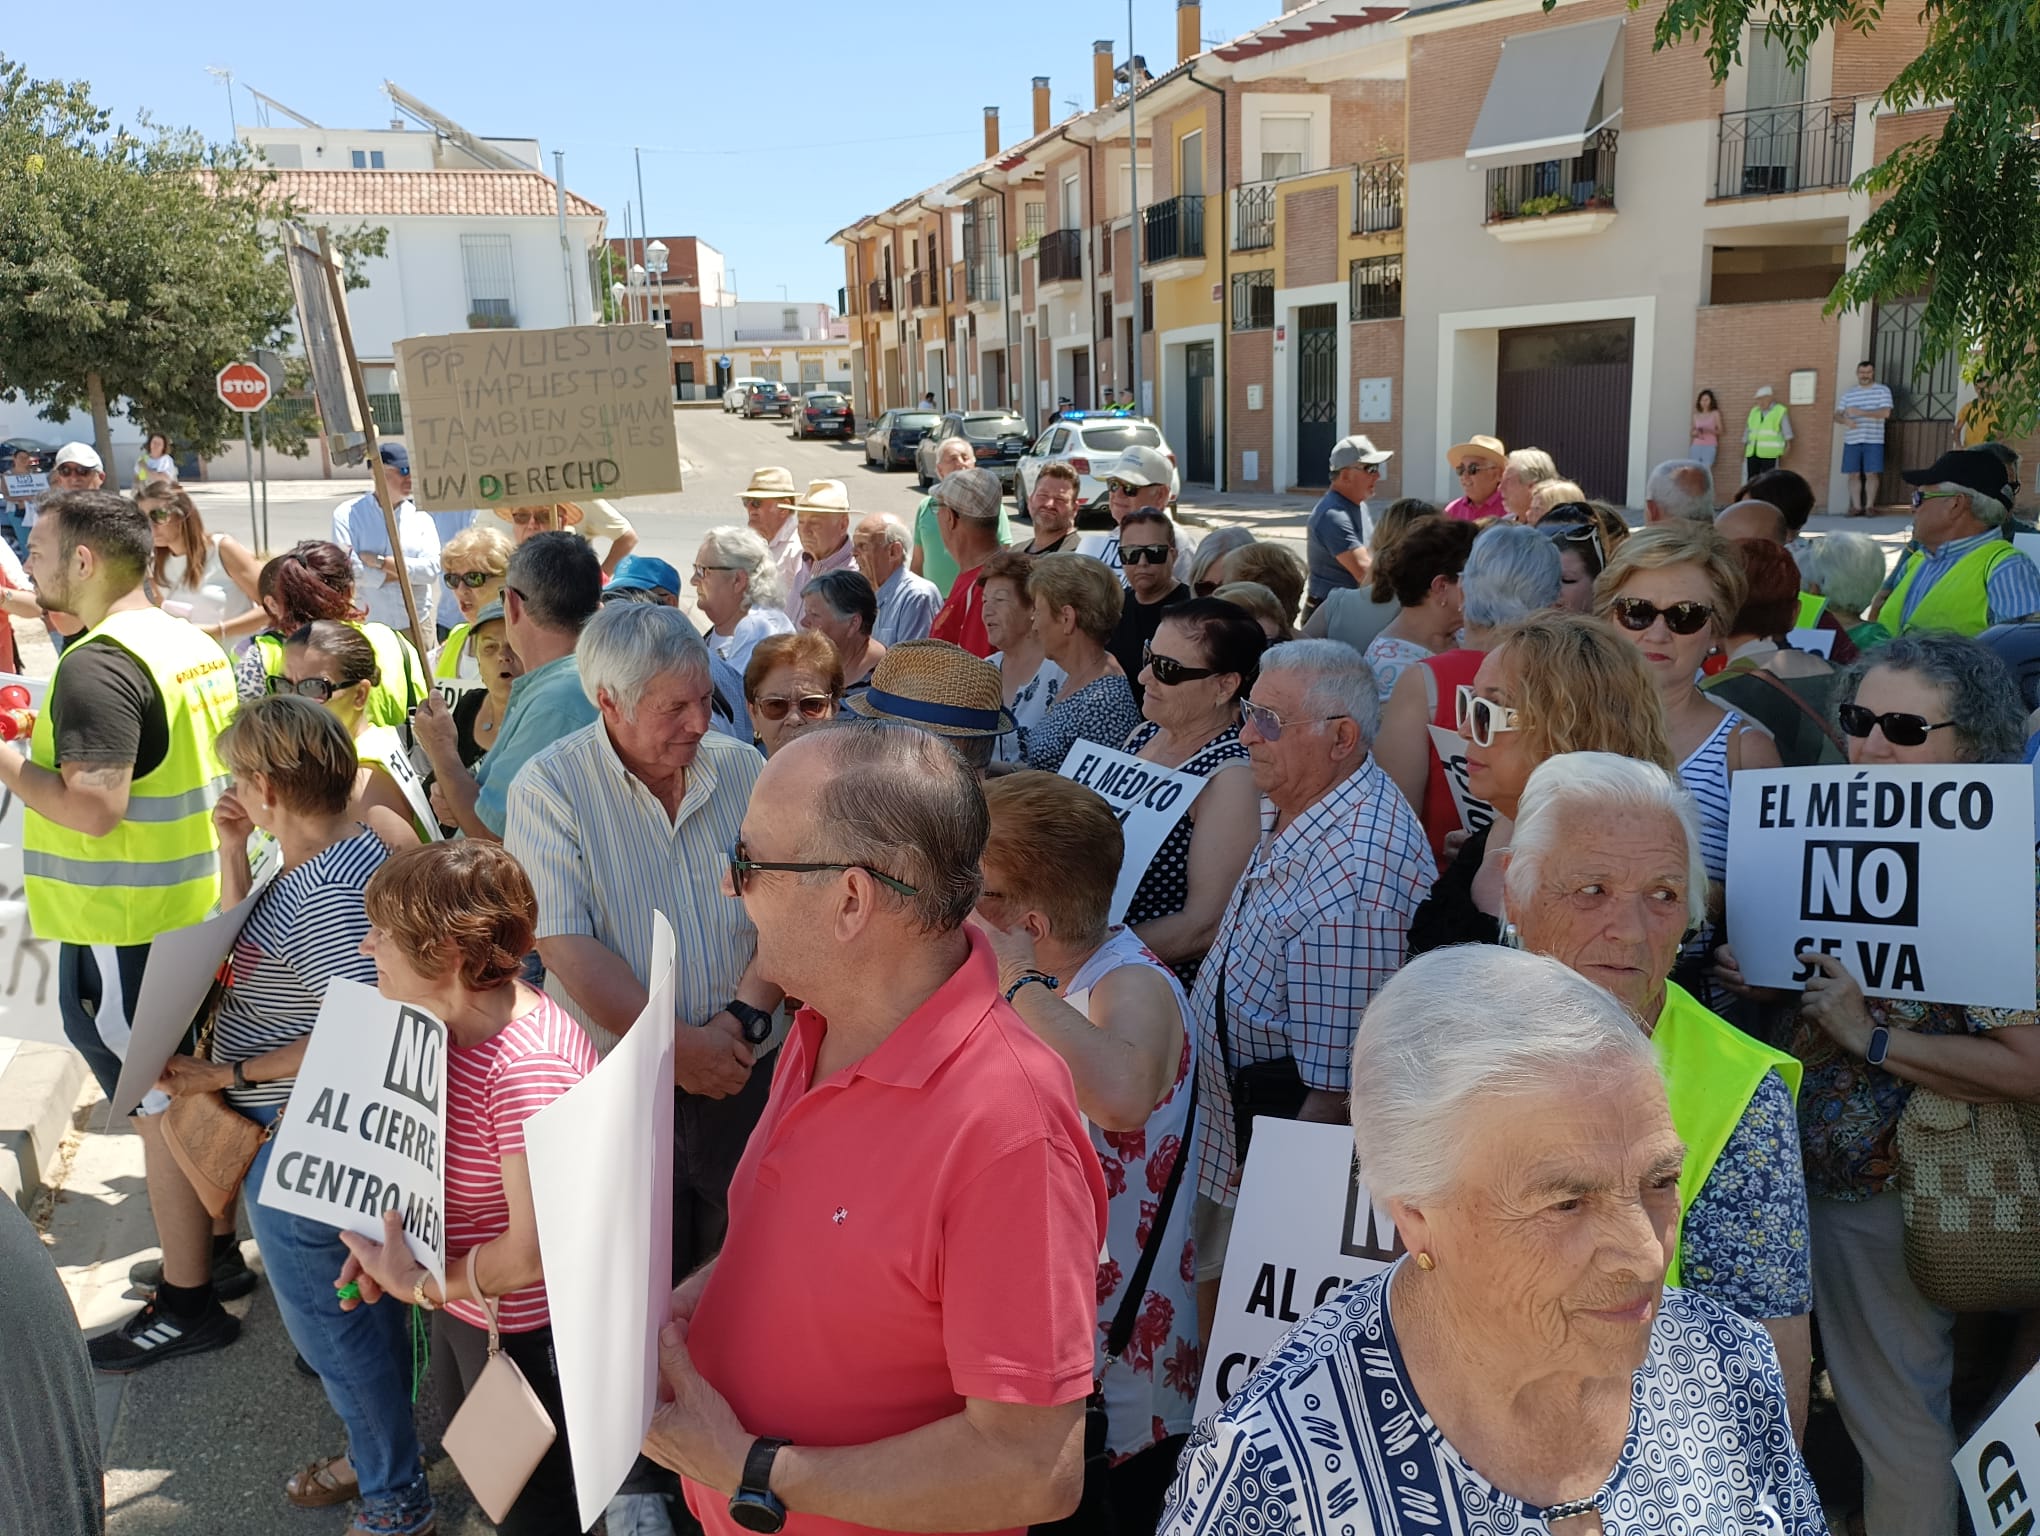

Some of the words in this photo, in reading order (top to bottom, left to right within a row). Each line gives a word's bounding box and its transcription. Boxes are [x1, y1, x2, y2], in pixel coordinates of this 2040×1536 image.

[222, 380, 266, 394] STOP
[409, 345, 467, 387] PP
[484, 330, 659, 375] NUESTOS
[463, 364, 649, 408] IMPUESTOS
[418, 406, 568, 446] TAMBIEN
[580, 397, 669, 430] SUMAN
[423, 447, 457, 470] LA
[627, 426, 665, 447] ES
[423, 473, 466, 501] UN
[480, 458, 620, 498] DERECHO
[1072, 754, 1102, 787] EL
[1093, 762, 1183, 812] MÉDICO
[1759, 785, 1795, 828] EL
[1805, 771, 1994, 830] MÉDICO
[1808, 847, 1908, 919] NO
[1856, 941, 1925, 991] VA
[391, 1013, 441, 1102] NO
[306, 1087, 350, 1133] AL
[359, 1102, 437, 1173] CIERRE
[276, 1151, 401, 1218] CENTRO
[1245, 1263, 1300, 1323] AL
